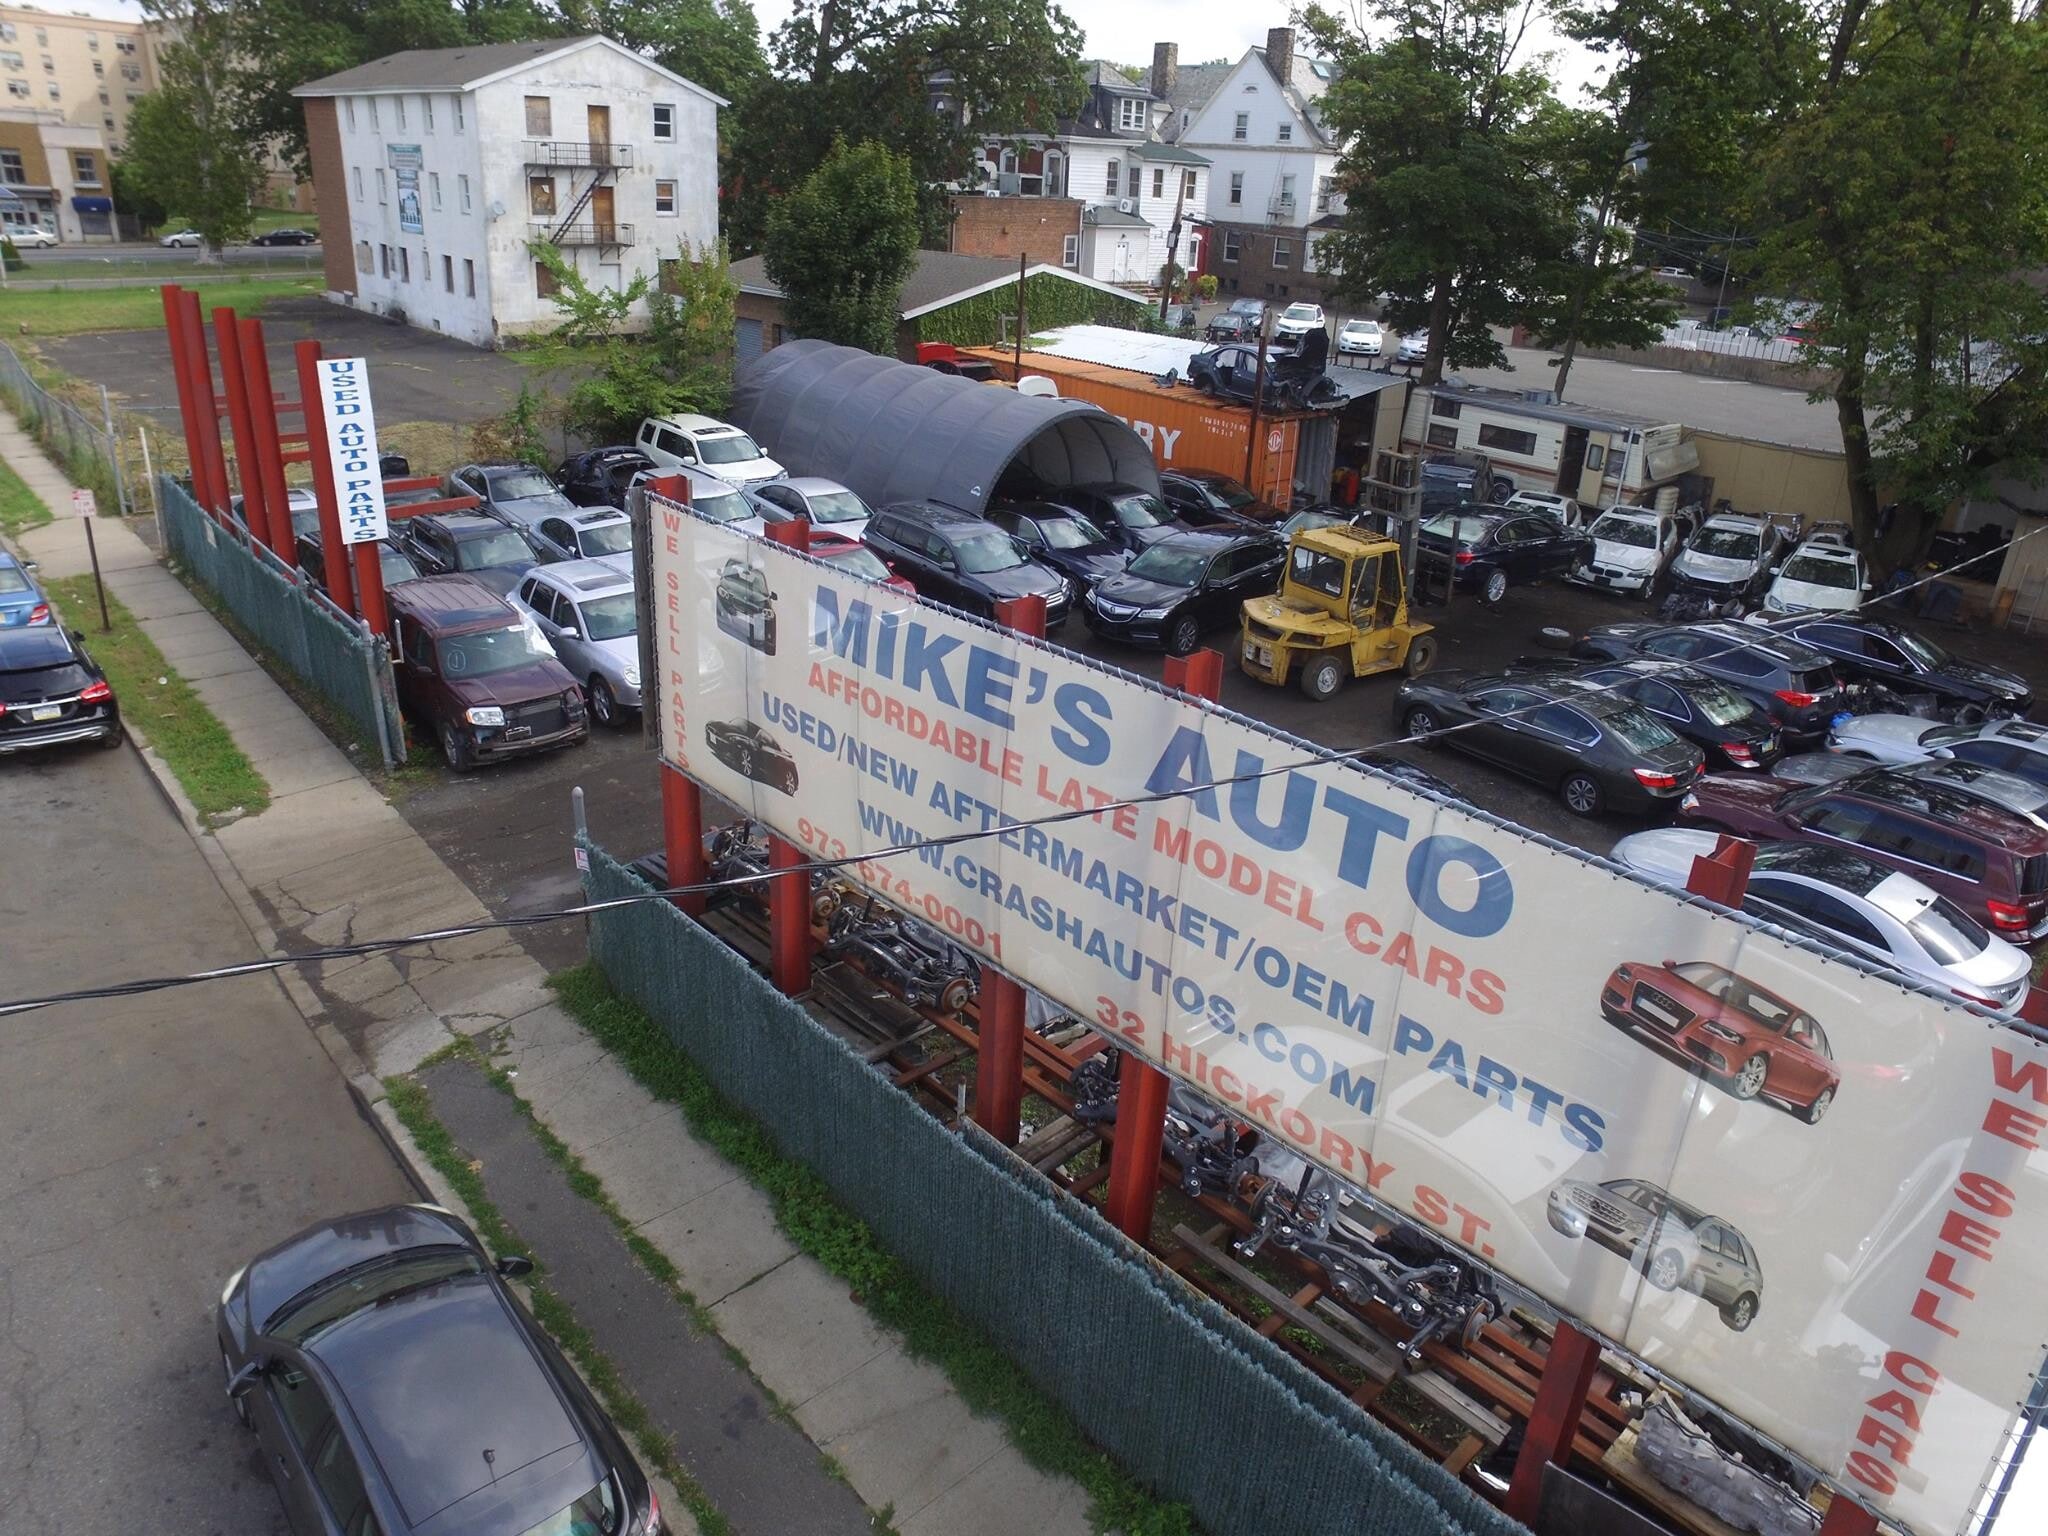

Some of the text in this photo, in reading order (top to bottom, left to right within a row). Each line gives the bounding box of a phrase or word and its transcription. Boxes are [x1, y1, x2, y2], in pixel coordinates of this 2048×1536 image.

[328, 361, 377, 541] USED AUTO PARTS
[663, 511, 689, 770] WE SELL PARTS
[815, 585, 1514, 939] MIKE'S AUTO
[763, 690, 1607, 1153] USED/NEW AFTERMARKET/OEM PARTS
[797, 817, 1002, 961] 973674-0001
[808, 662, 1508, 1016] AFFORDABLE LATE MODEL CARS
[856, 798, 1377, 1116] WWW.CRASHAUTOS.COM
[1095, 996, 1497, 1258] 32 HICKORY ST.
[1845, 1046, 2048, 1497] WE SELL CARS
